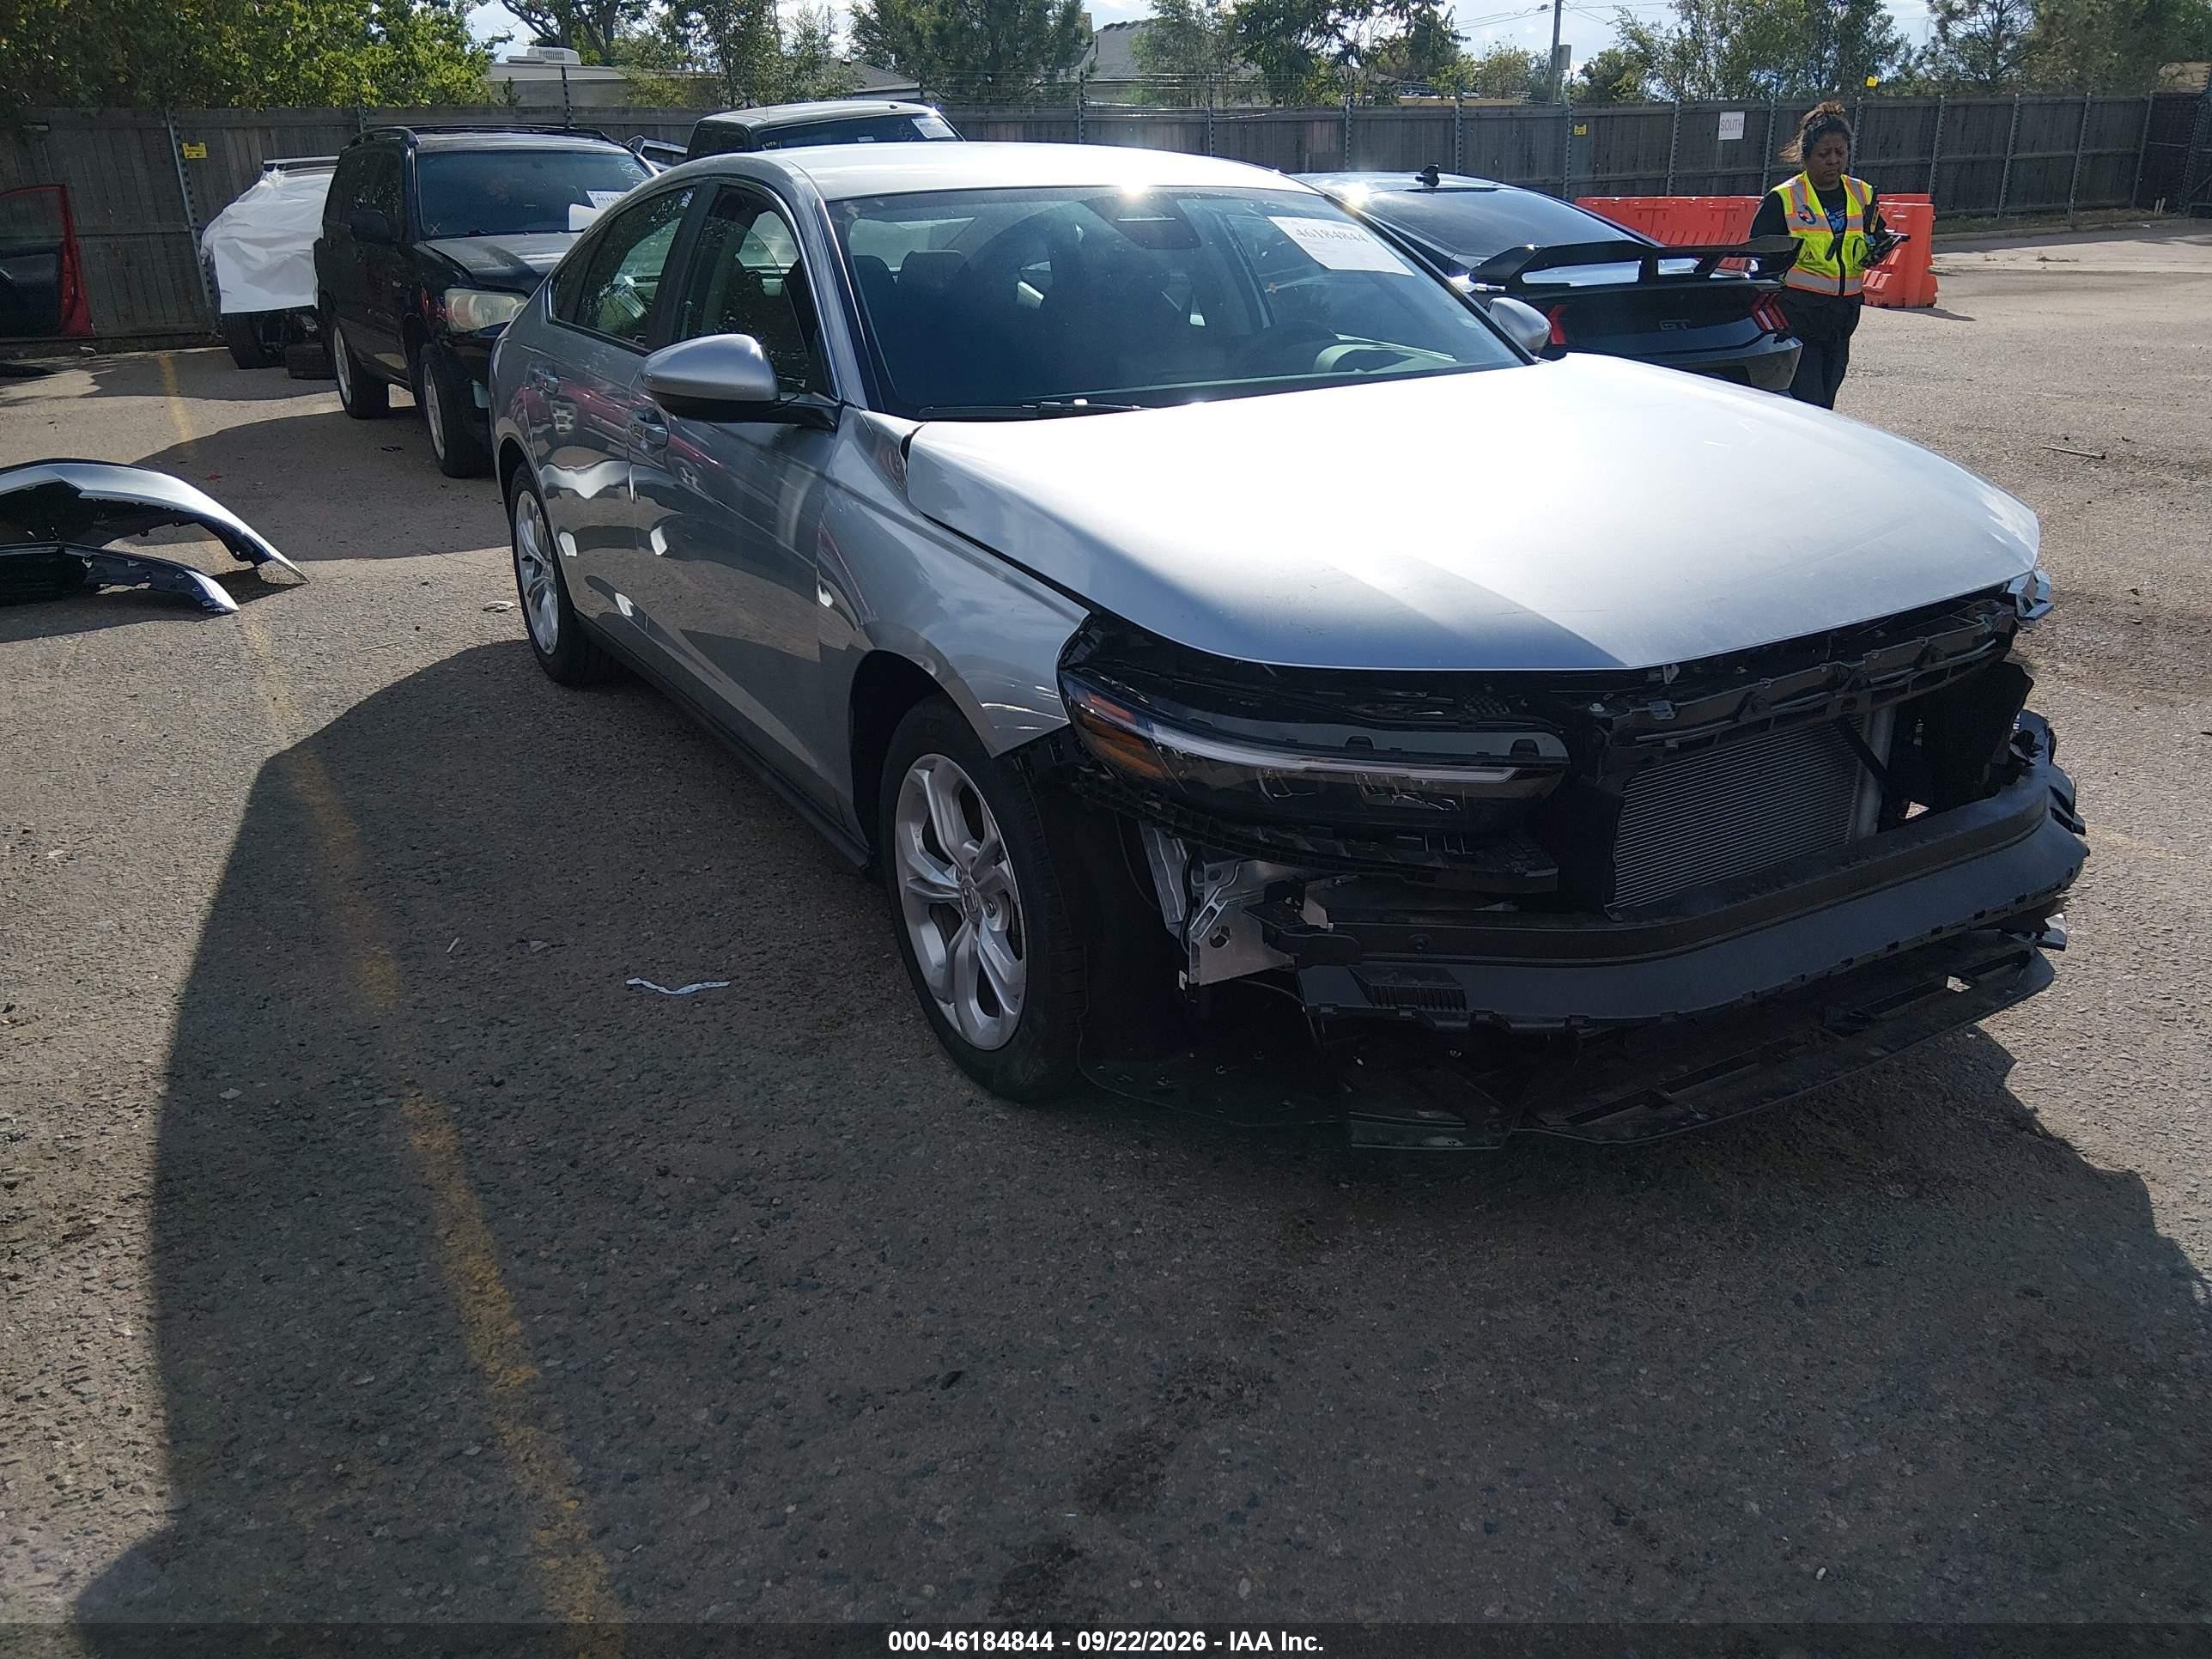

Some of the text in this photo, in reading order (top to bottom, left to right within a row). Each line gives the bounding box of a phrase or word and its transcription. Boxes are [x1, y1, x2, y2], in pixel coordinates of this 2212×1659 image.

[1720, 118, 1743, 131] SOUTH
[1296, 228, 1369, 243] 46184844
[1658, 319, 1690, 331] GT
